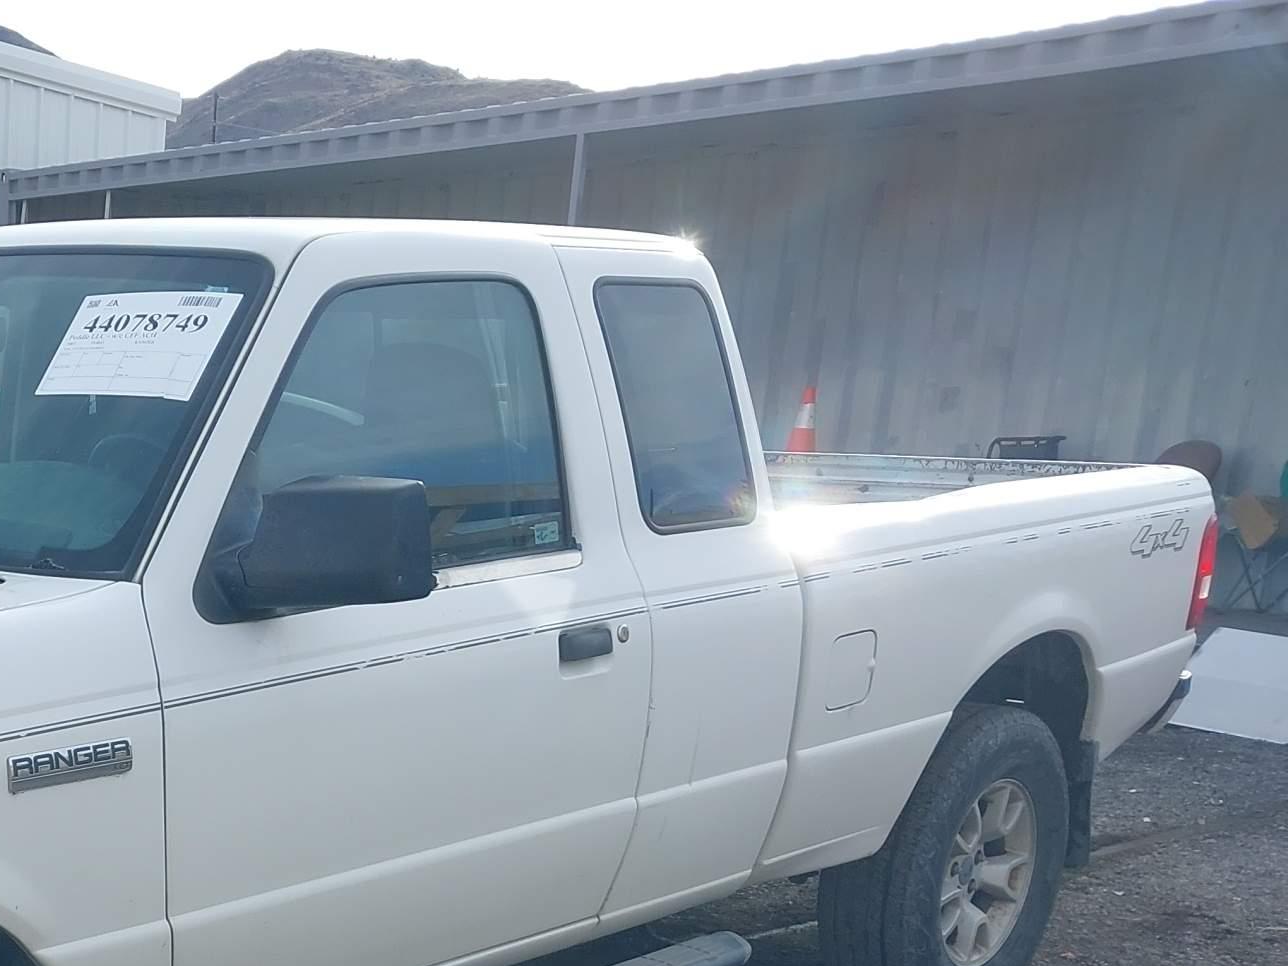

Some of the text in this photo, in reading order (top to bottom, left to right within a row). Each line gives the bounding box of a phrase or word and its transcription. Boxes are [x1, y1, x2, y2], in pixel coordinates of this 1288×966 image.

[83, 313, 209, 333] 44078749
[1129, 518, 1190, 559] 4x4
[12, 739, 131, 777] RANGER
